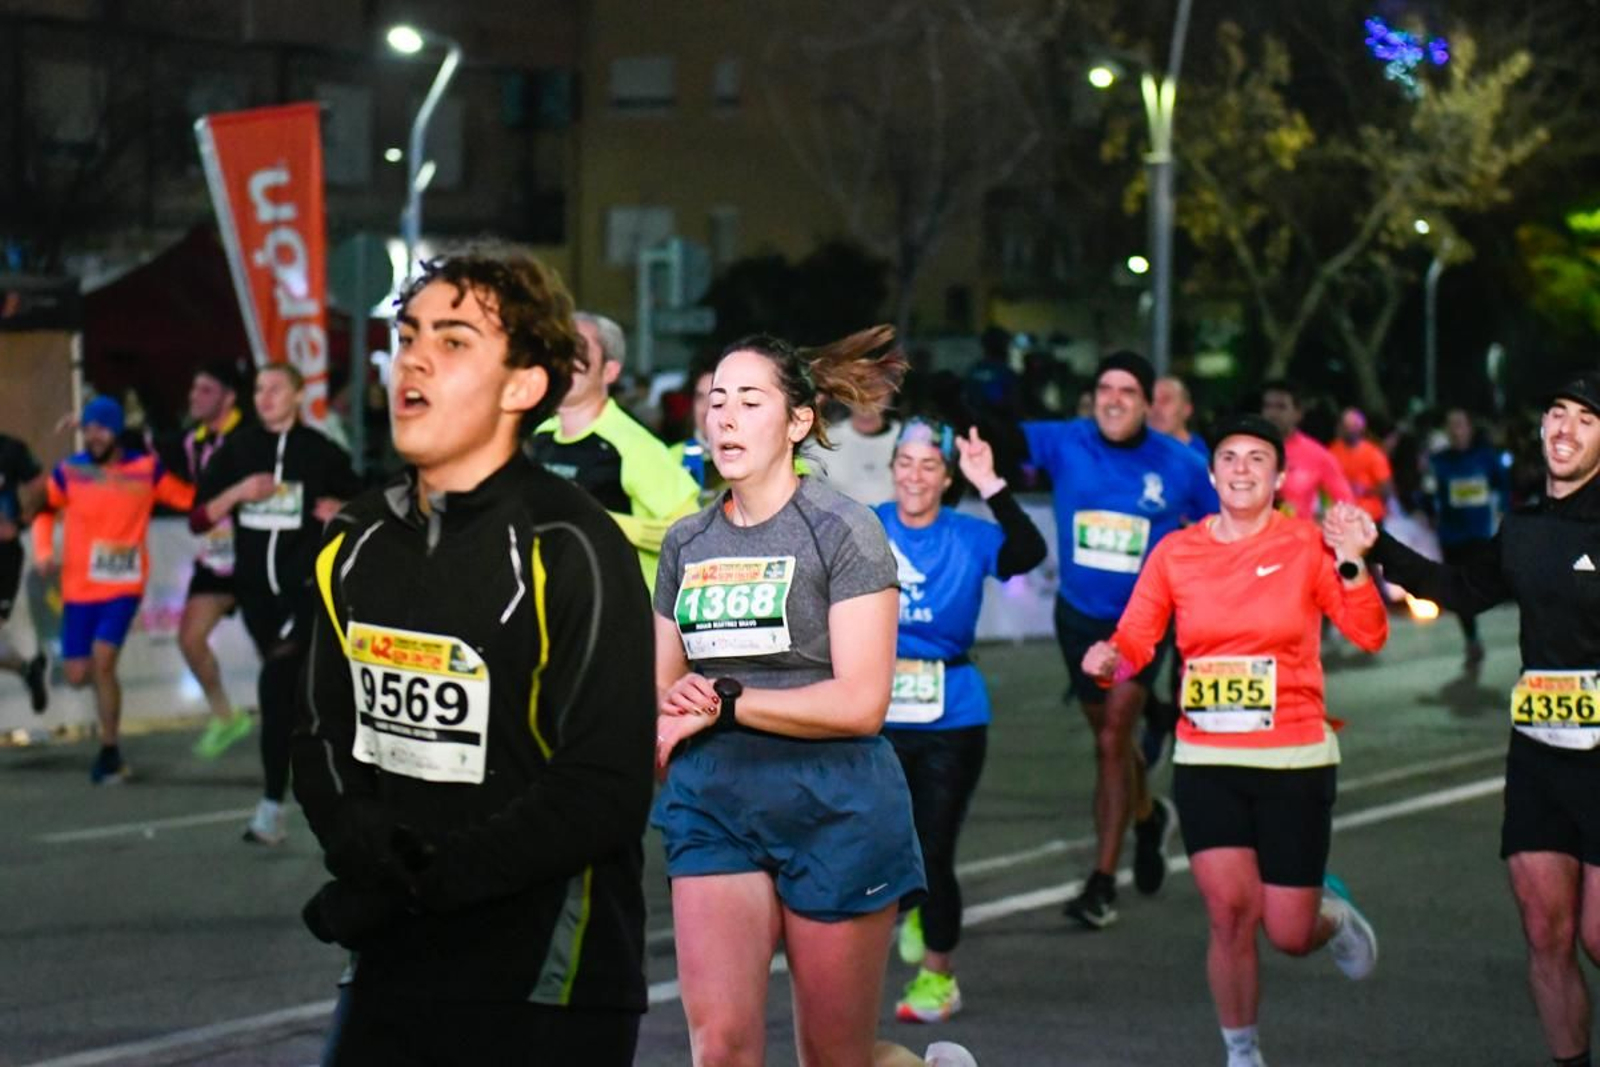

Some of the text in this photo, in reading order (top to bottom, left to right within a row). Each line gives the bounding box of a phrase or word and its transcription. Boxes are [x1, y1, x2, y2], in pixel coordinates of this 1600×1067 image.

[685, 584, 776, 621] 1368
[361, 667, 468, 726] 9569
[892, 673, 934, 699] 25
[1190, 678, 1264, 704] 3155
[1517, 694, 1595, 720] 4356
